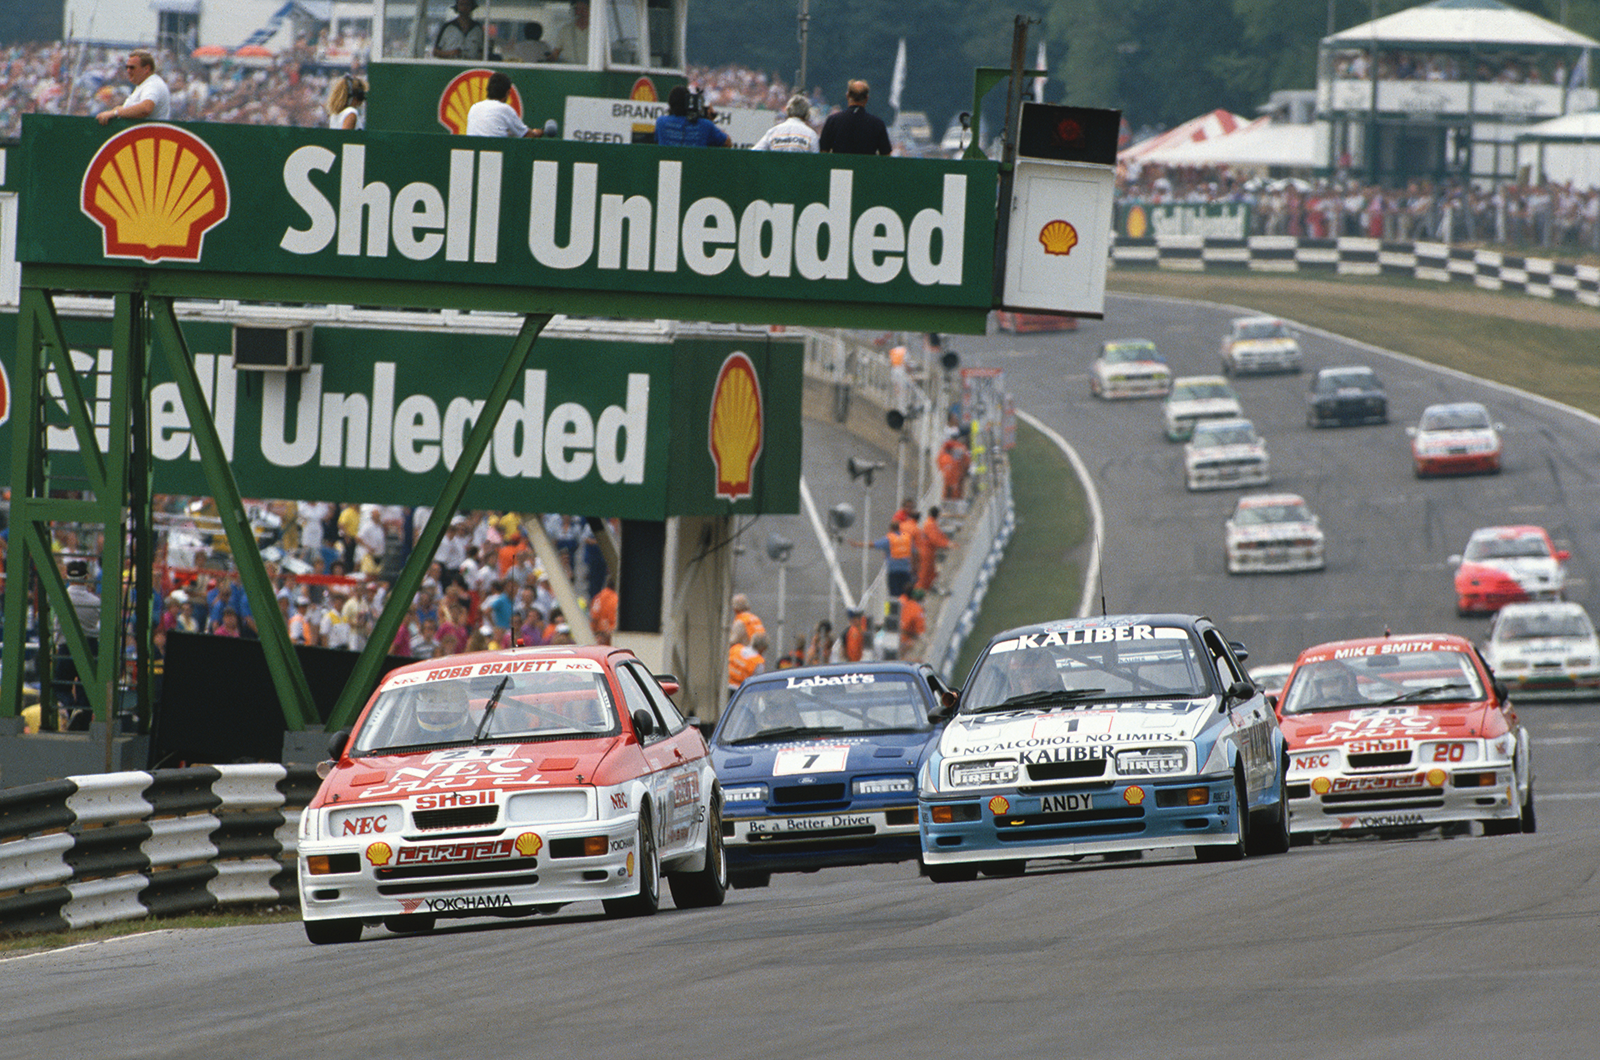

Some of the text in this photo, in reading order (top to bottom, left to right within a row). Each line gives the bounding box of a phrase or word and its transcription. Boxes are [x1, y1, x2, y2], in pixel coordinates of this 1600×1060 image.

[611, 103, 670, 118] BRAND
[573, 129, 624, 144] SPEED
[280, 144, 967, 286] Shell Unleaded
[260, 362, 650, 484] Unleaded
[1017, 624, 1154, 650] KALIBER
[1334, 646, 1376, 660] MIKE
[1381, 642, 1434, 654] SMITH
[426, 666, 473, 682] ROBB
[478, 660, 557, 676] GRAVETT
[786, 673, 875, 689] Labatt's
[1063, 718, 1080, 733] 1
[1327, 716, 1434, 733] NEC
[964, 731, 1179, 755] NO ALCOHOL. NO LIMITS.
[1305, 725, 1449, 745] CARTEL
[1019, 745, 1116, 765] KALIBER
[1349, 739, 1409, 753] Shell
[1433, 743, 1465, 762] 20
[802, 754, 821, 769] 7
[1120, 753, 1184, 770] PIRELLI
[1295, 754, 1330, 770] NEC
[389, 759, 534, 784] NEC
[953, 766, 1014, 784] PIRELLI
[358, 774, 550, 799] CARTEL
[860, 779, 910, 794] PIRELLI
[1333, 775, 1424, 792] CARTEL
[416, 791, 496, 810] Shell
[610, 792, 628, 810] NEC
[1042, 794, 1092, 812] ANDY
[343, 815, 387, 836] NEC
[749, 815, 871, 832] Be a Better Driver
[1358, 814, 1425, 828] YOKOHAMA
[399, 842, 510, 862] CARTEL
[424, 893, 513, 912] YOKOHAMA
